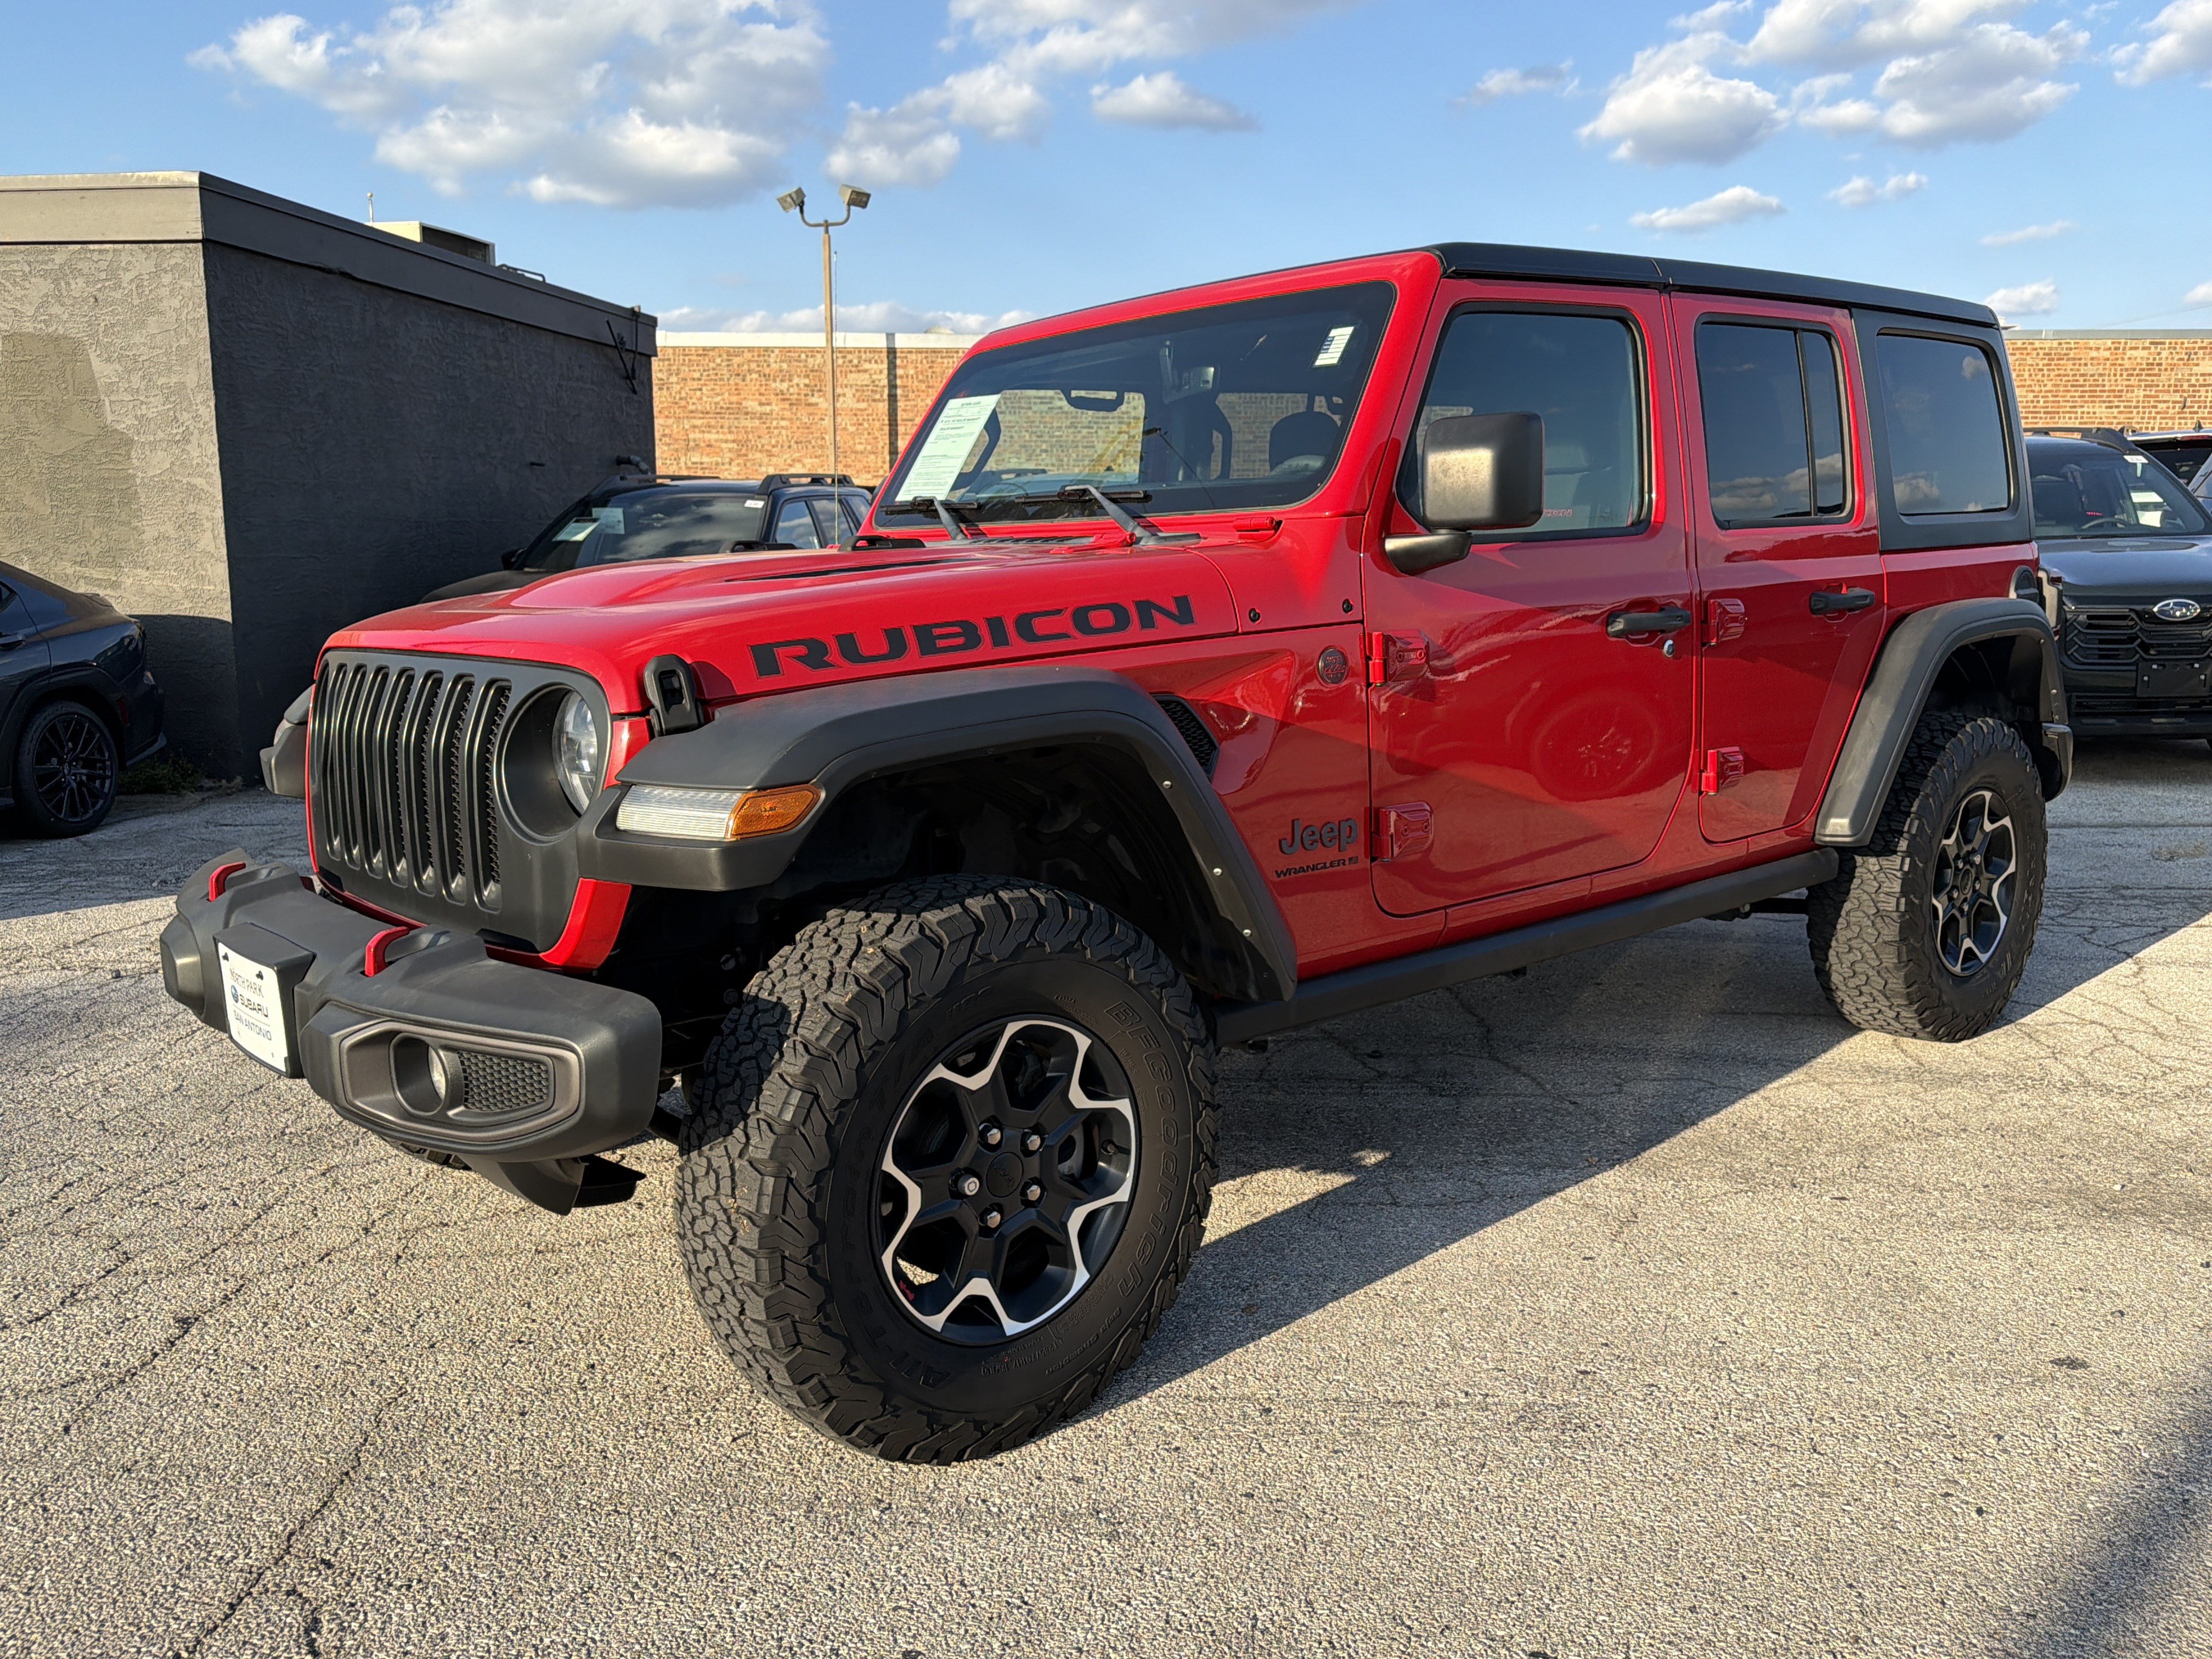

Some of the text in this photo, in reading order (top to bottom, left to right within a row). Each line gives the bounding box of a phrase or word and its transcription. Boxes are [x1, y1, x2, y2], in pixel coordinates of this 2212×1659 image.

[747, 594, 1197, 680] RUBICON
[1278, 817, 1358, 855] Jeep
[1274, 858, 1347, 879] WRANGLER
[229, 967, 264, 998] NORTH PARK
[239, 993, 269, 1018] SUBARU
[245, 1017, 272, 1041] ANTONIO
[1103, 1000, 1179, 1298] BFGoodrich
